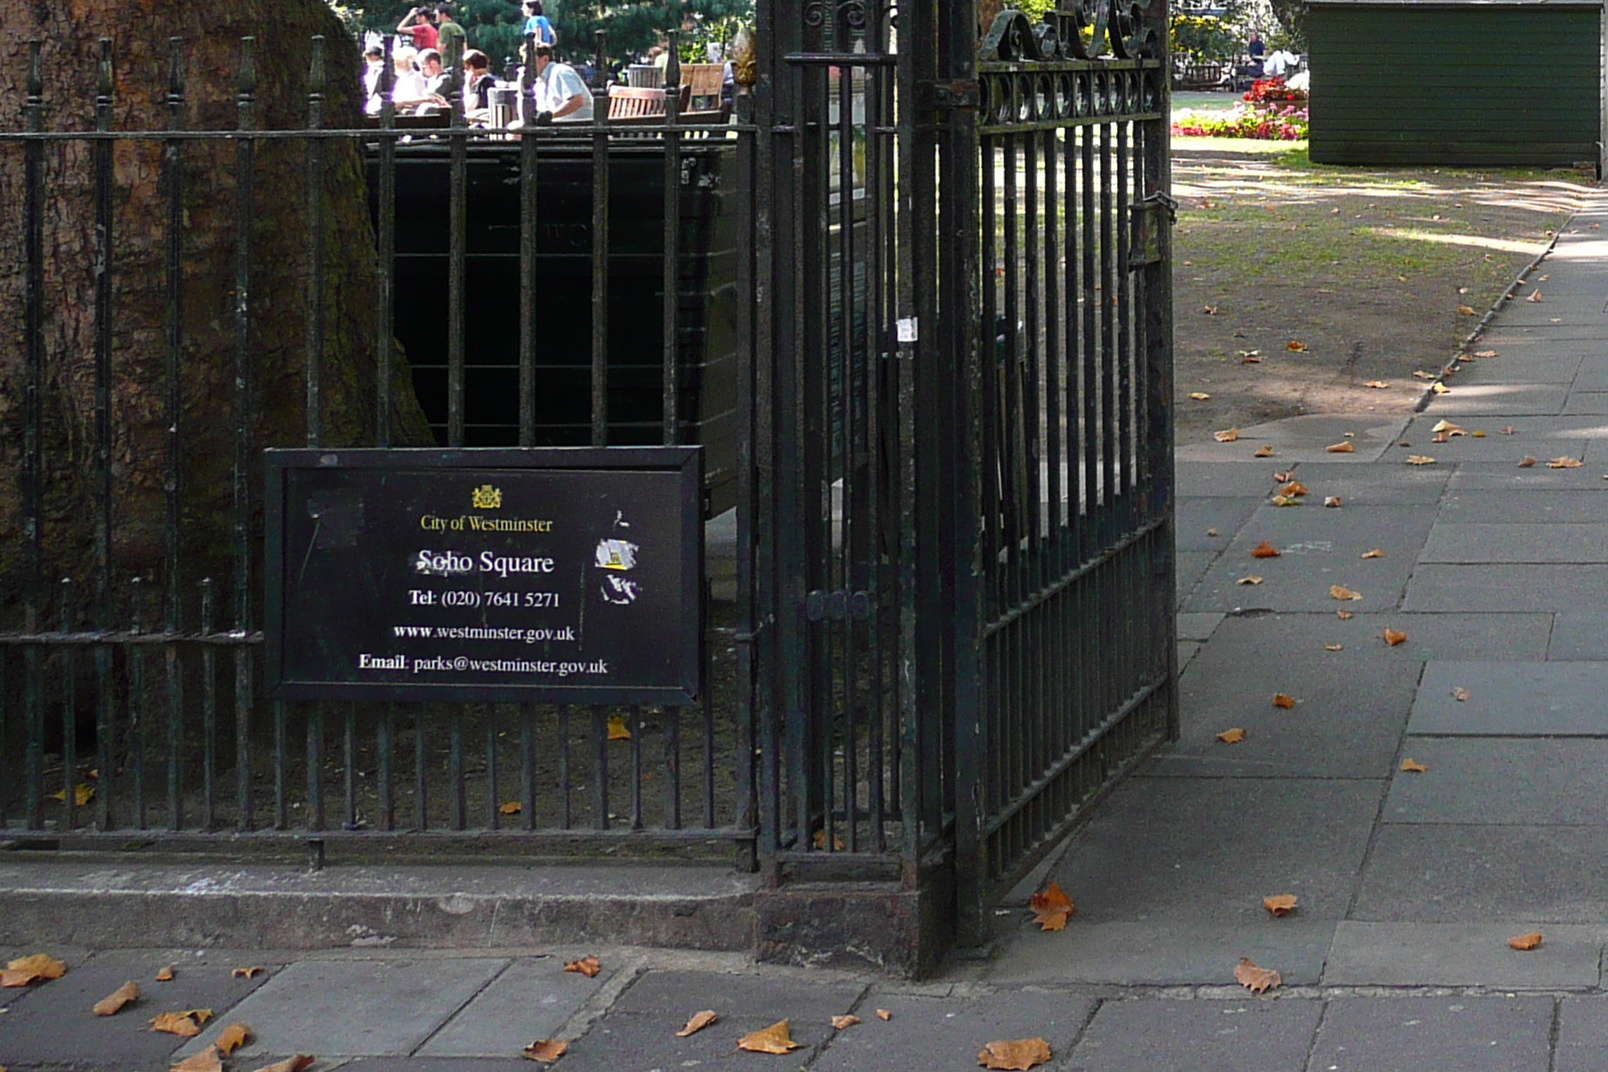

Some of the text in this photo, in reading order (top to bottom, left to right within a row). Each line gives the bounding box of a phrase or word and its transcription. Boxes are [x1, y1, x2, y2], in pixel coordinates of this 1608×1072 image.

[420, 514, 553, 532] City of Westminster
[418, 548, 554, 578] Soho Square
[409, 589, 560, 608] Tel: (020) 7641 5271
[394, 624, 575, 643] www.westminster.gov.uk
[358, 653, 608, 676] Email: parks@westminster.gov.uk
